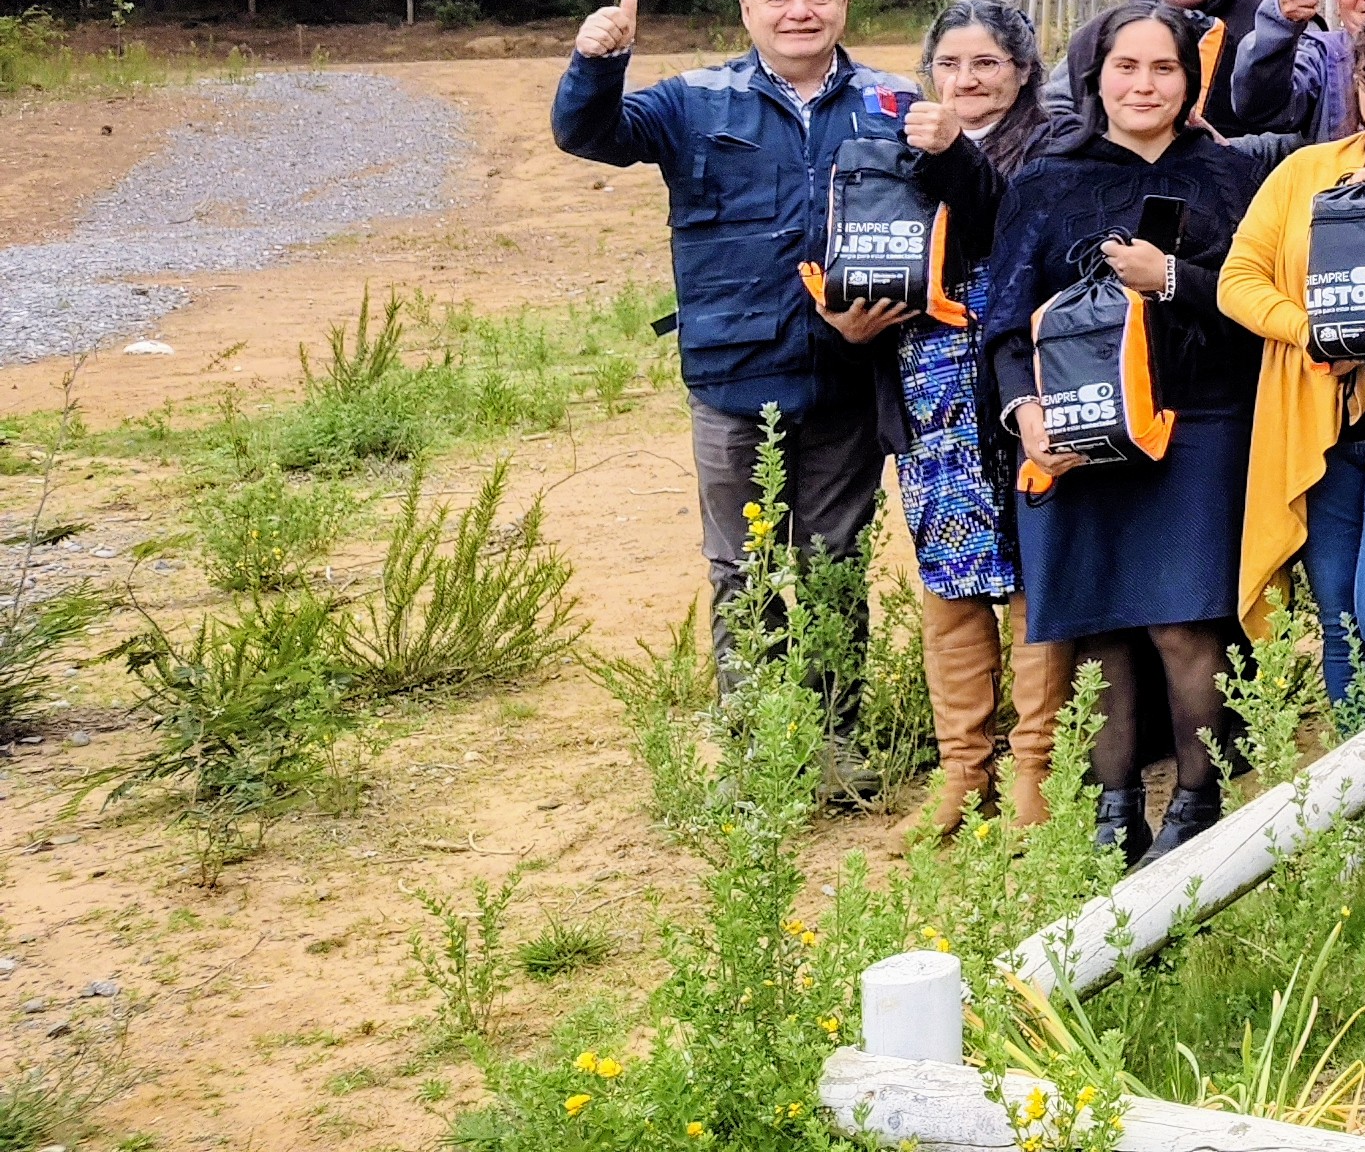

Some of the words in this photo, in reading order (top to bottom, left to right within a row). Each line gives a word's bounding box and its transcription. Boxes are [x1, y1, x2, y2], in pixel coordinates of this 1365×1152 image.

[836, 222, 890, 233] SIEMPRE
[834, 234, 924, 254] LISTOS
[1042, 399, 1117, 429] ISTOS
